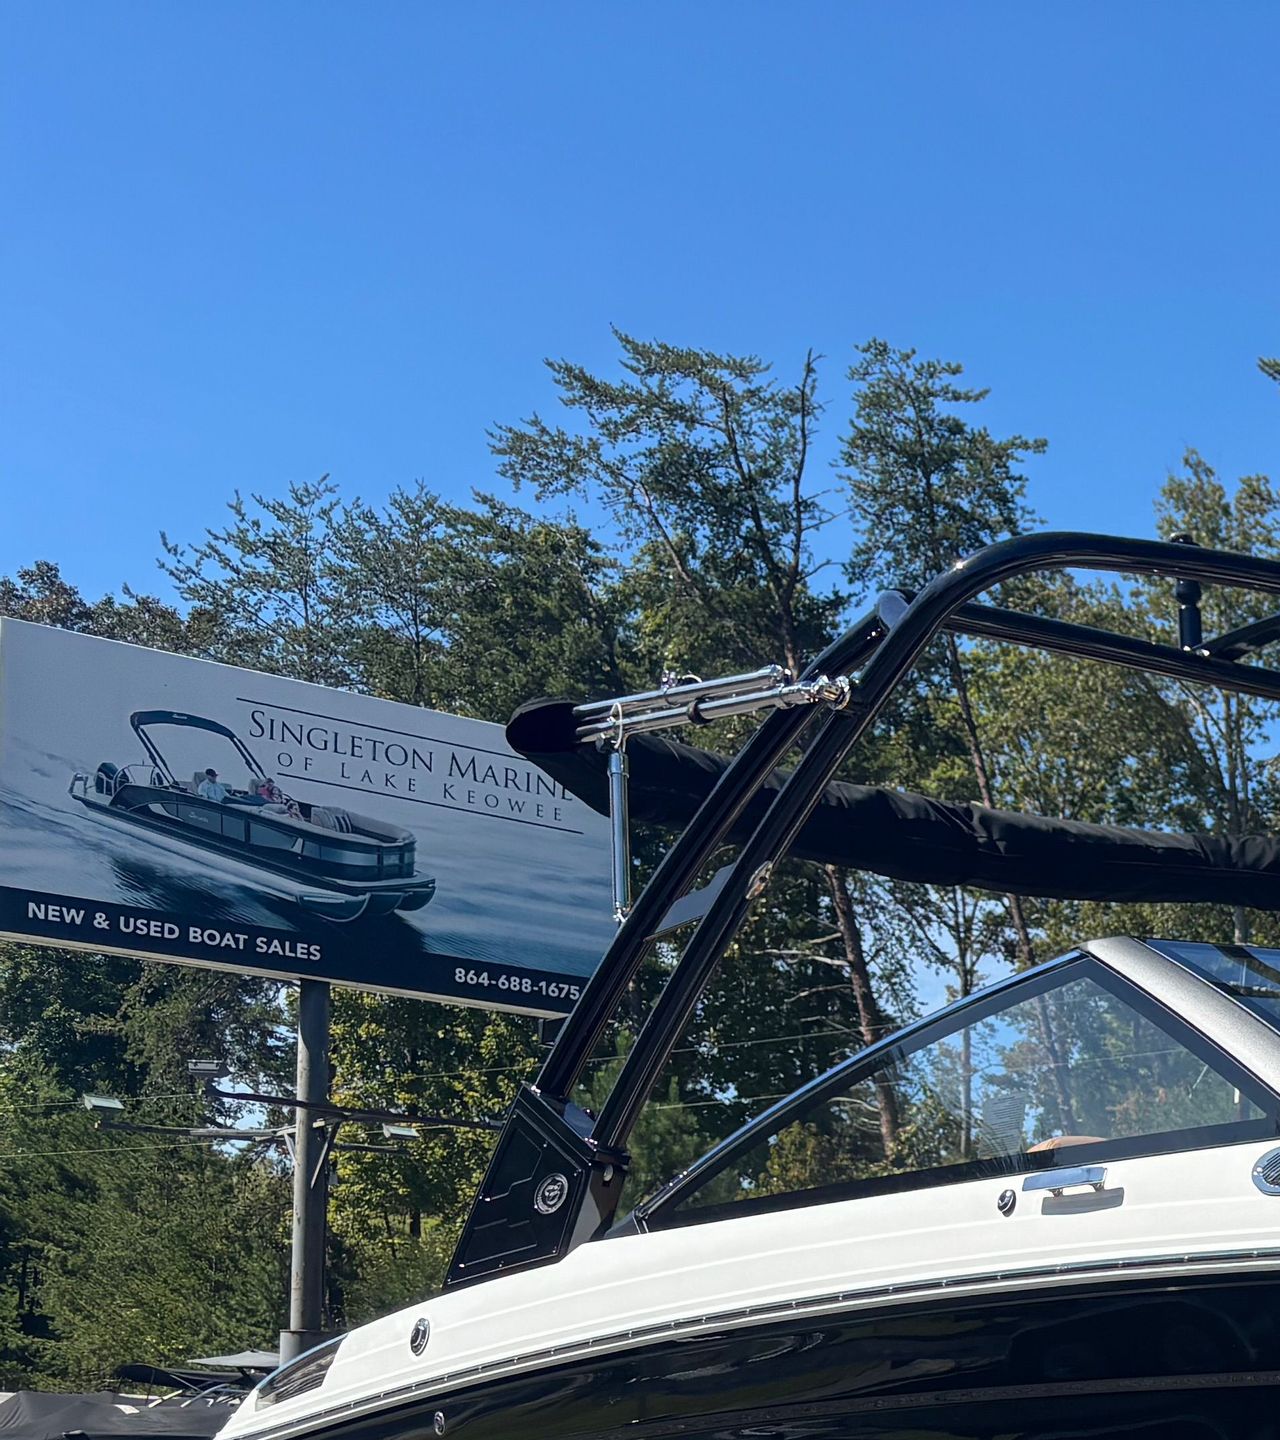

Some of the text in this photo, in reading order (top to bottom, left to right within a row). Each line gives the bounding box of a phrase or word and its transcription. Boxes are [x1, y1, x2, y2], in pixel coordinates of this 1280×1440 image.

[249, 710, 434, 773] SINGLETON
[277, 752, 563, 822] OF LAKE KEOWEE
[27, 901, 323, 962] NEW & USED BOAT SALES
[454, 967, 581, 1001] 864-688-1675
